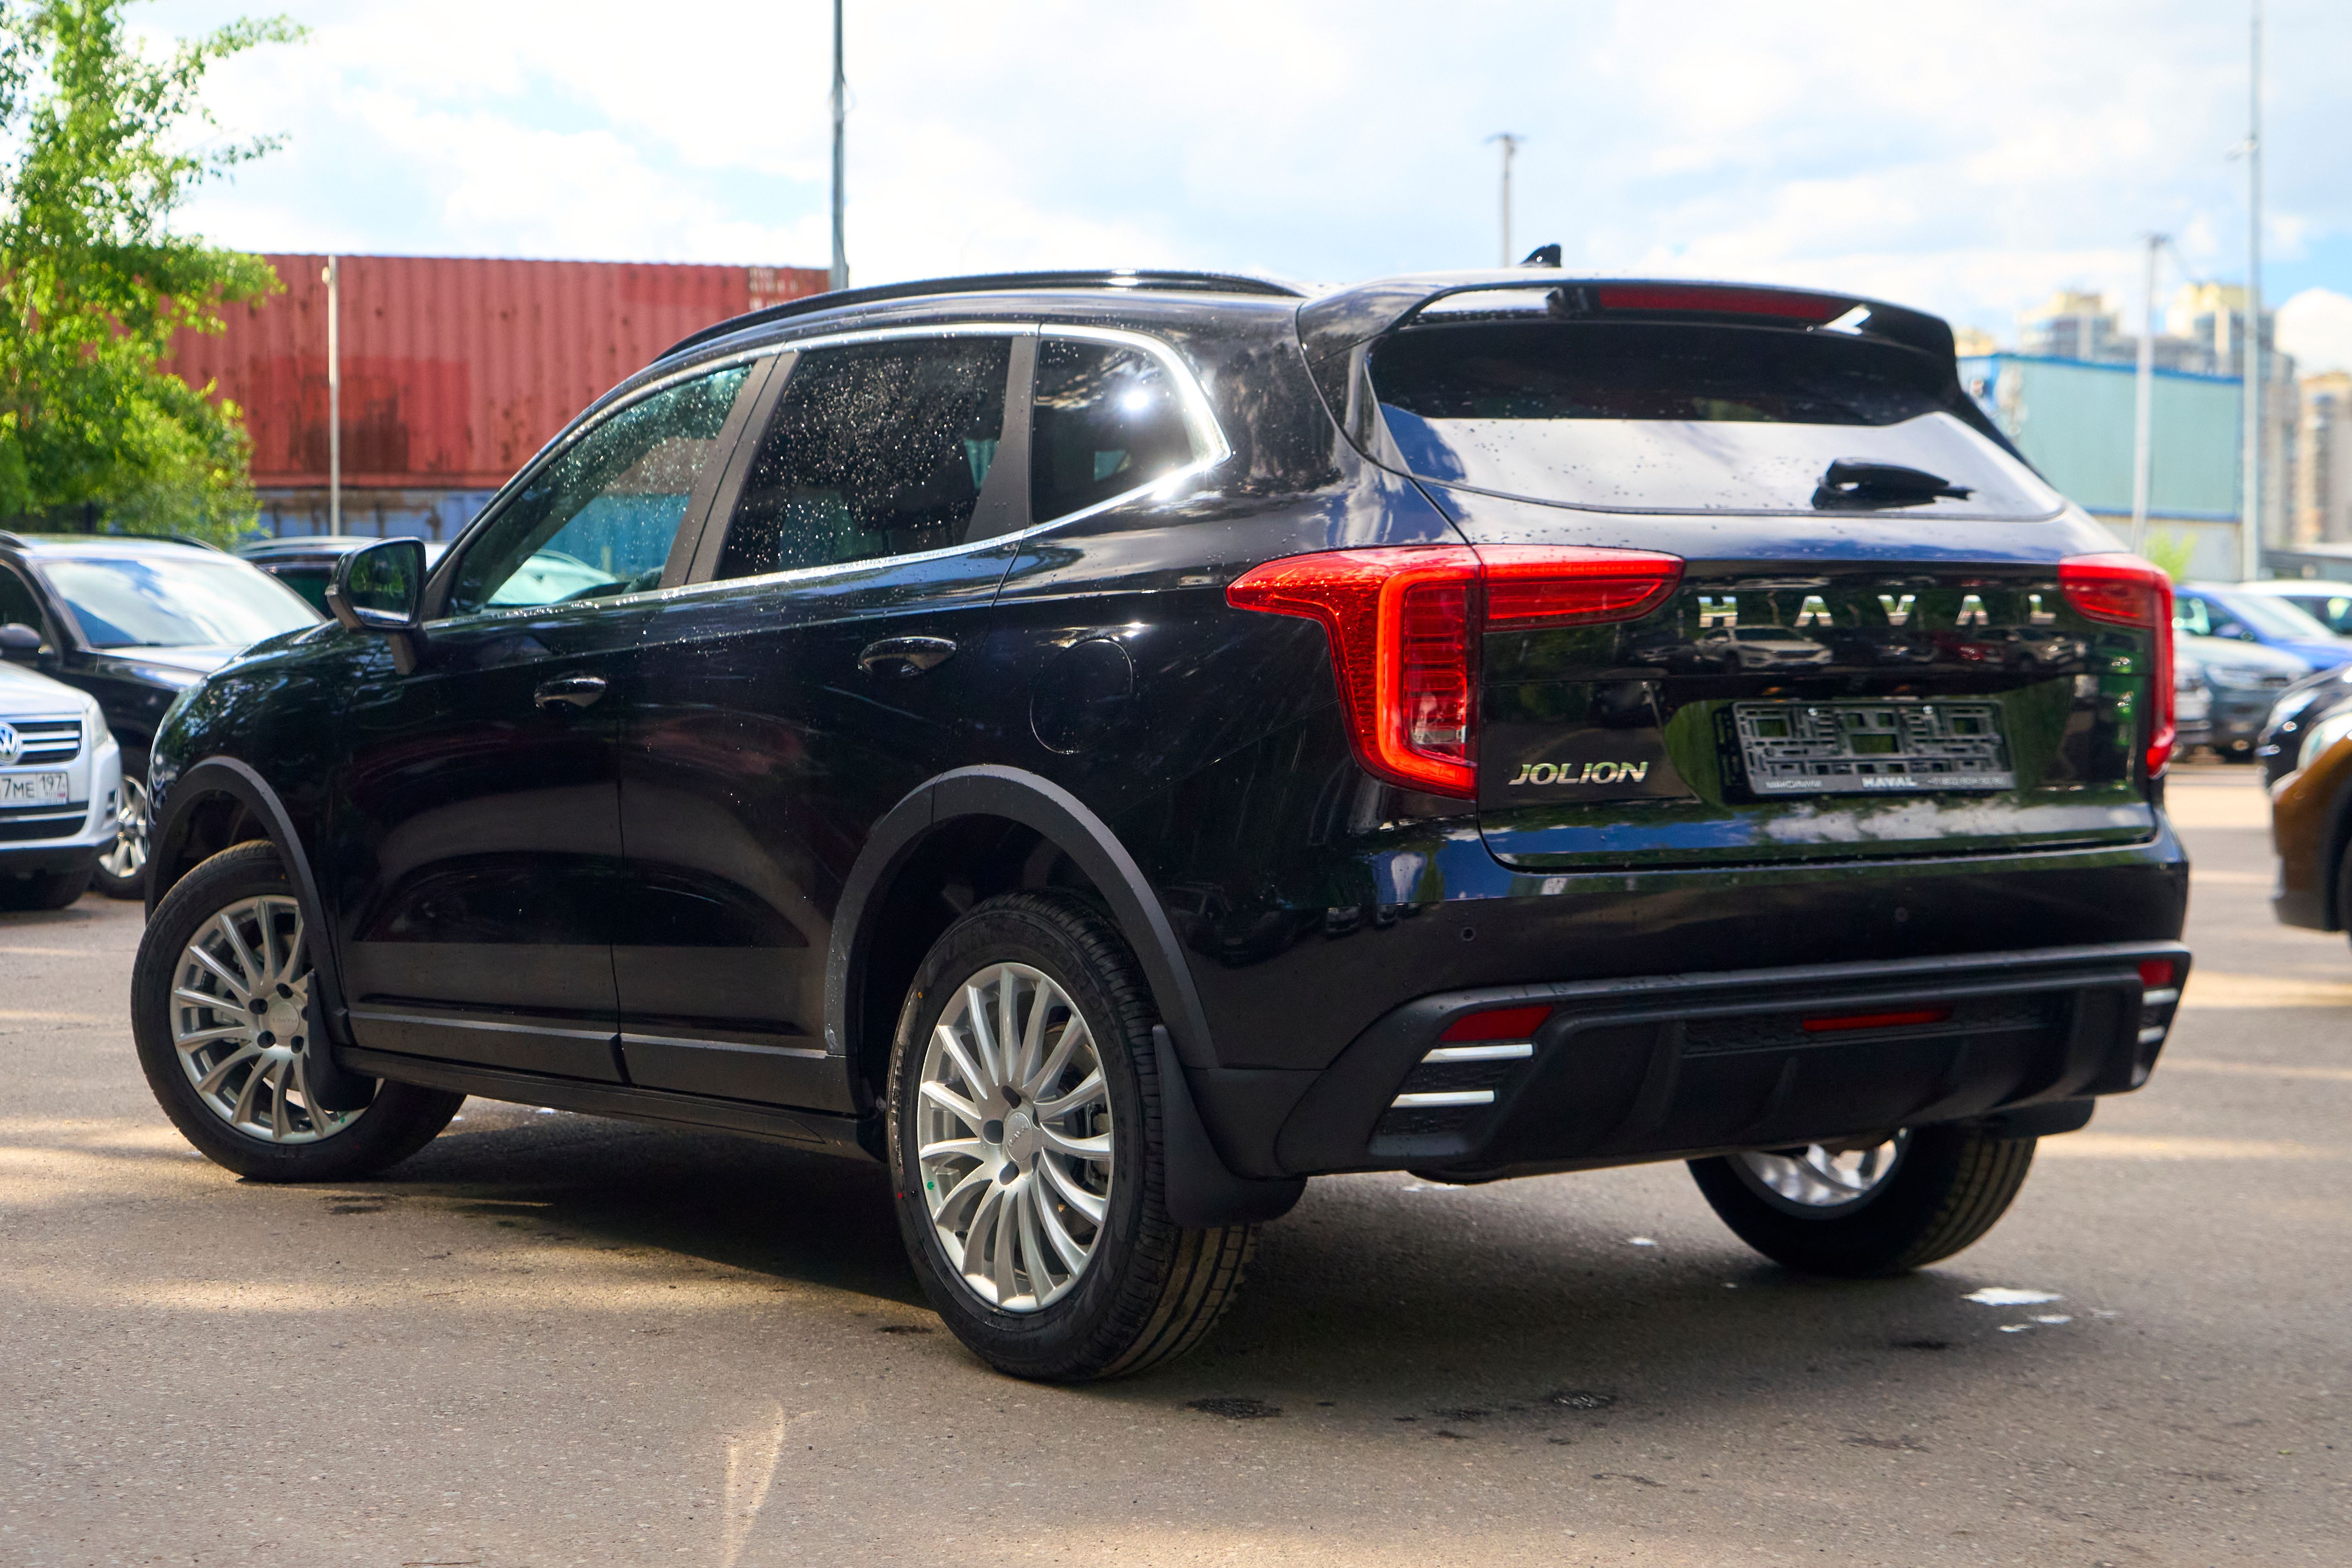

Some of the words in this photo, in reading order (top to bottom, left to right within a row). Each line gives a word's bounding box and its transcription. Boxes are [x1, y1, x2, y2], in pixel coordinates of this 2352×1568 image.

[1697, 594, 2057, 628] HAVAL
[1508, 761, 1649, 785] JOLION
[1861, 776, 1917, 788] HAVAL
